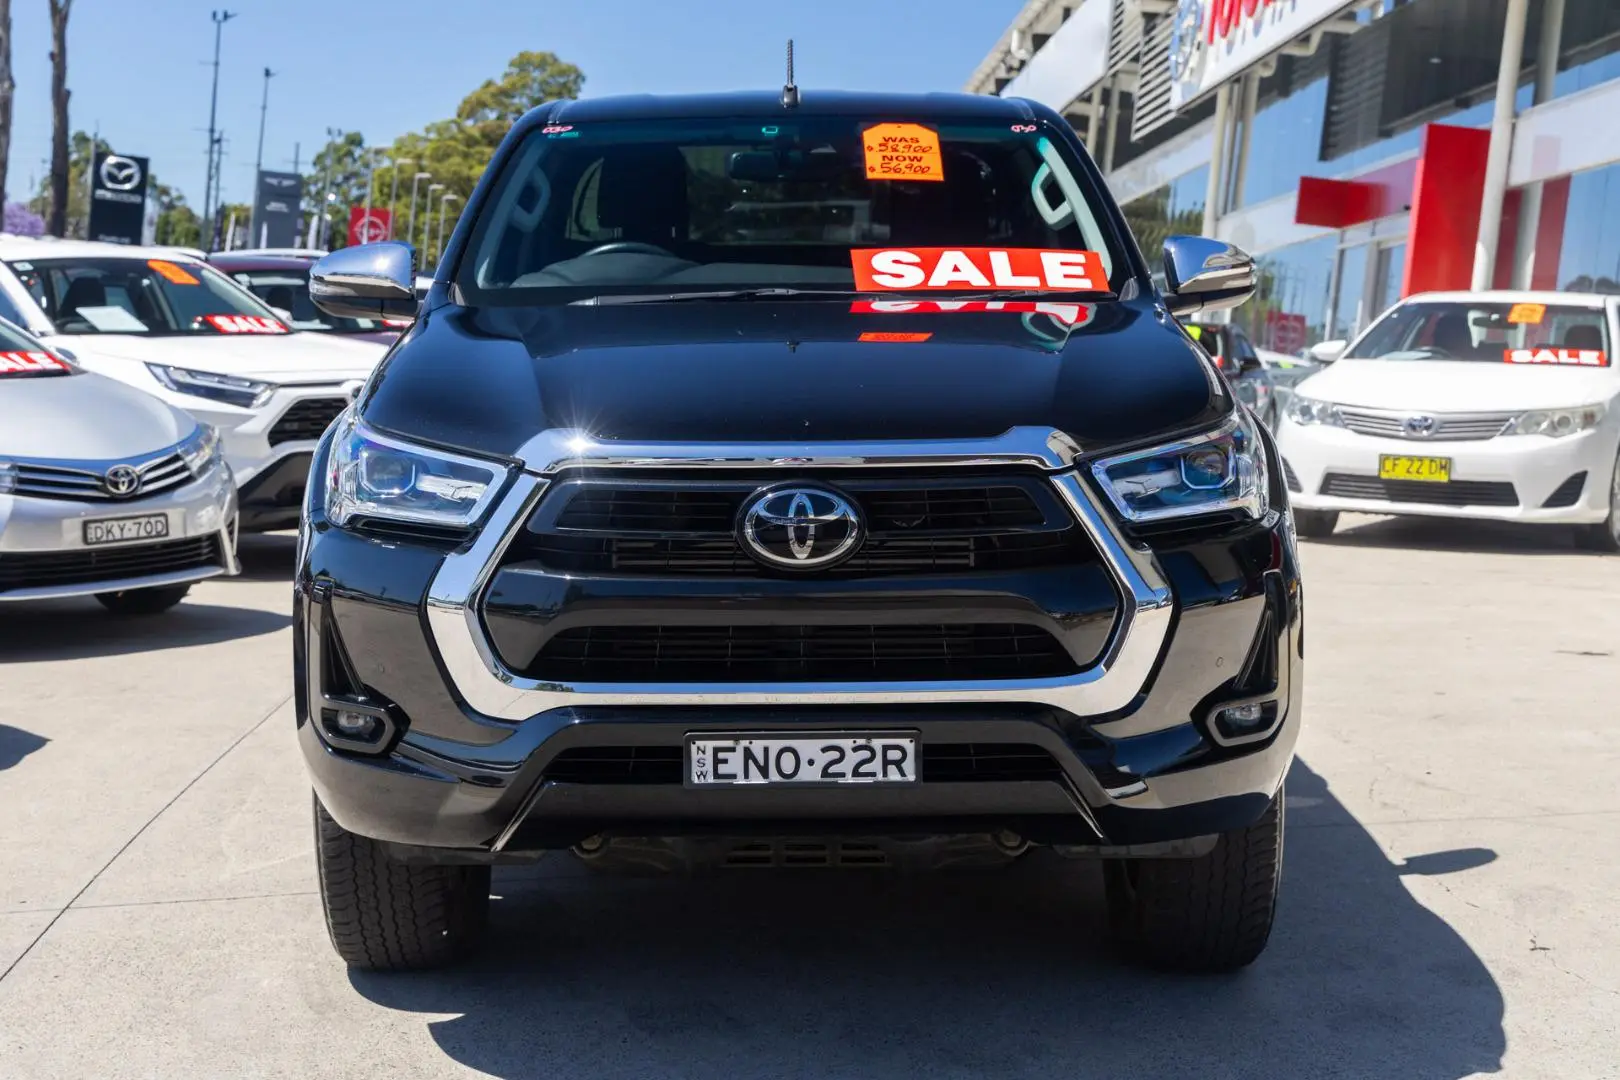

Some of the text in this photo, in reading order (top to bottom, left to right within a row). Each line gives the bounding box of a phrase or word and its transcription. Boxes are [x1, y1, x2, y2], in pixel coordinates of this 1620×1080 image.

[882, 136, 920, 144] WAS
[871, 250, 1093, 288] SALE
[213, 315, 288, 333] SALE
[0, 352, 63, 371] ALE
[1511, 349, 1600, 365] SALE
[1405, 457, 1425, 475] 22
[695, 745, 708, 781] NSW
